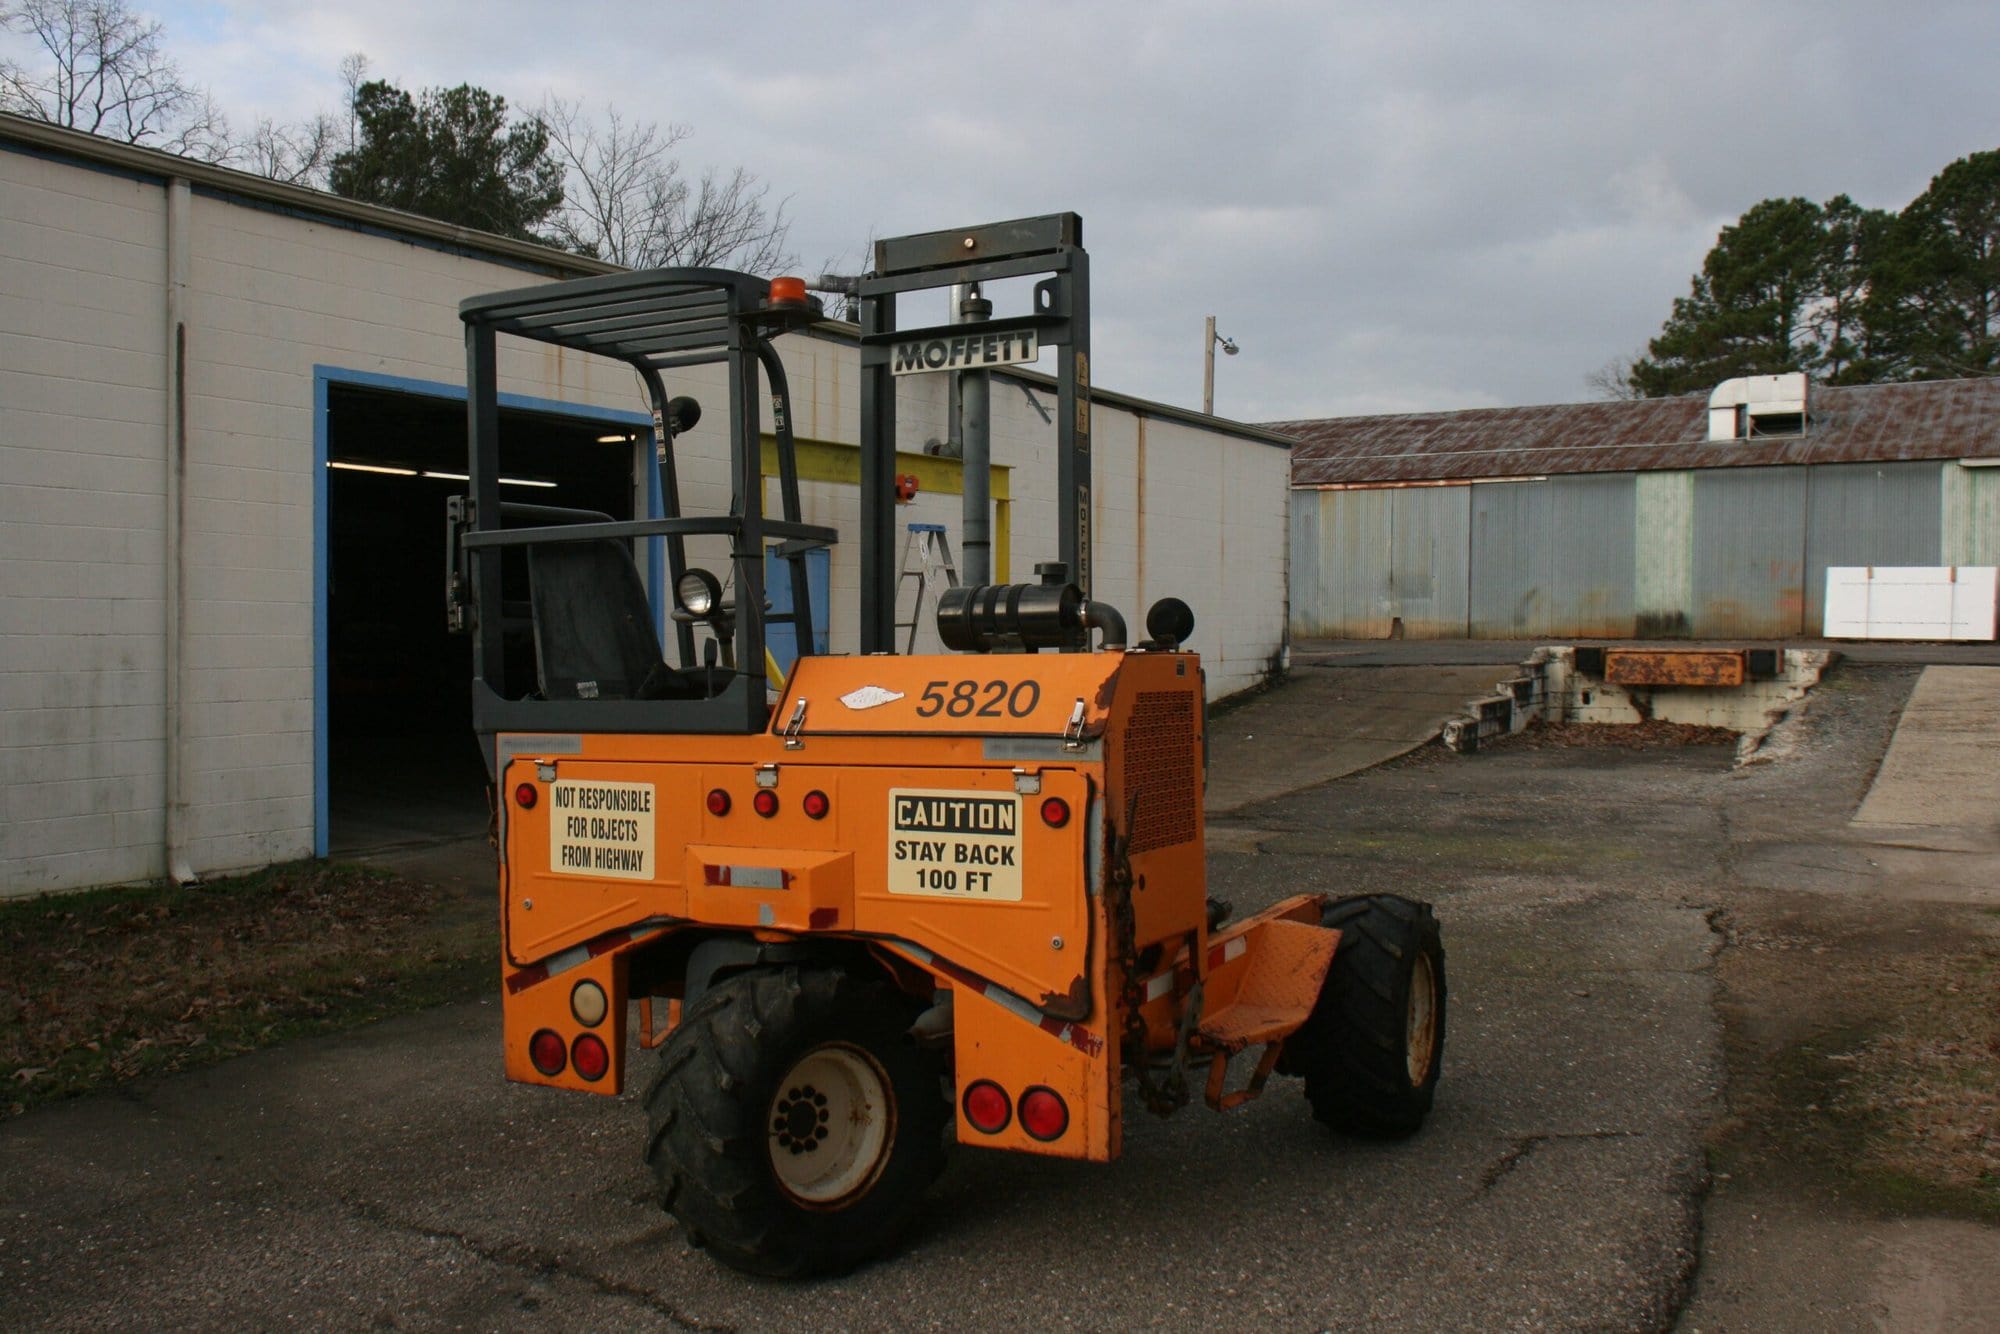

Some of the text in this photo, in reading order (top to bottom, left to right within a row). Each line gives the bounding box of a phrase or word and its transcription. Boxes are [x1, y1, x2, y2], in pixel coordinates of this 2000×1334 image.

[895, 331, 1034, 372] MOFFETT
[916, 679, 1040, 718] 5820
[555, 786, 651, 813] NOT RESPONSIBLE
[897, 799, 1014, 830] CAUTION
[567, 816, 638, 842] FOR OBJECTS
[562, 844, 644, 872] FROM HIGHWAY
[894, 839, 1015, 866] STAY BACK
[916, 868, 992, 892] 100 FT
